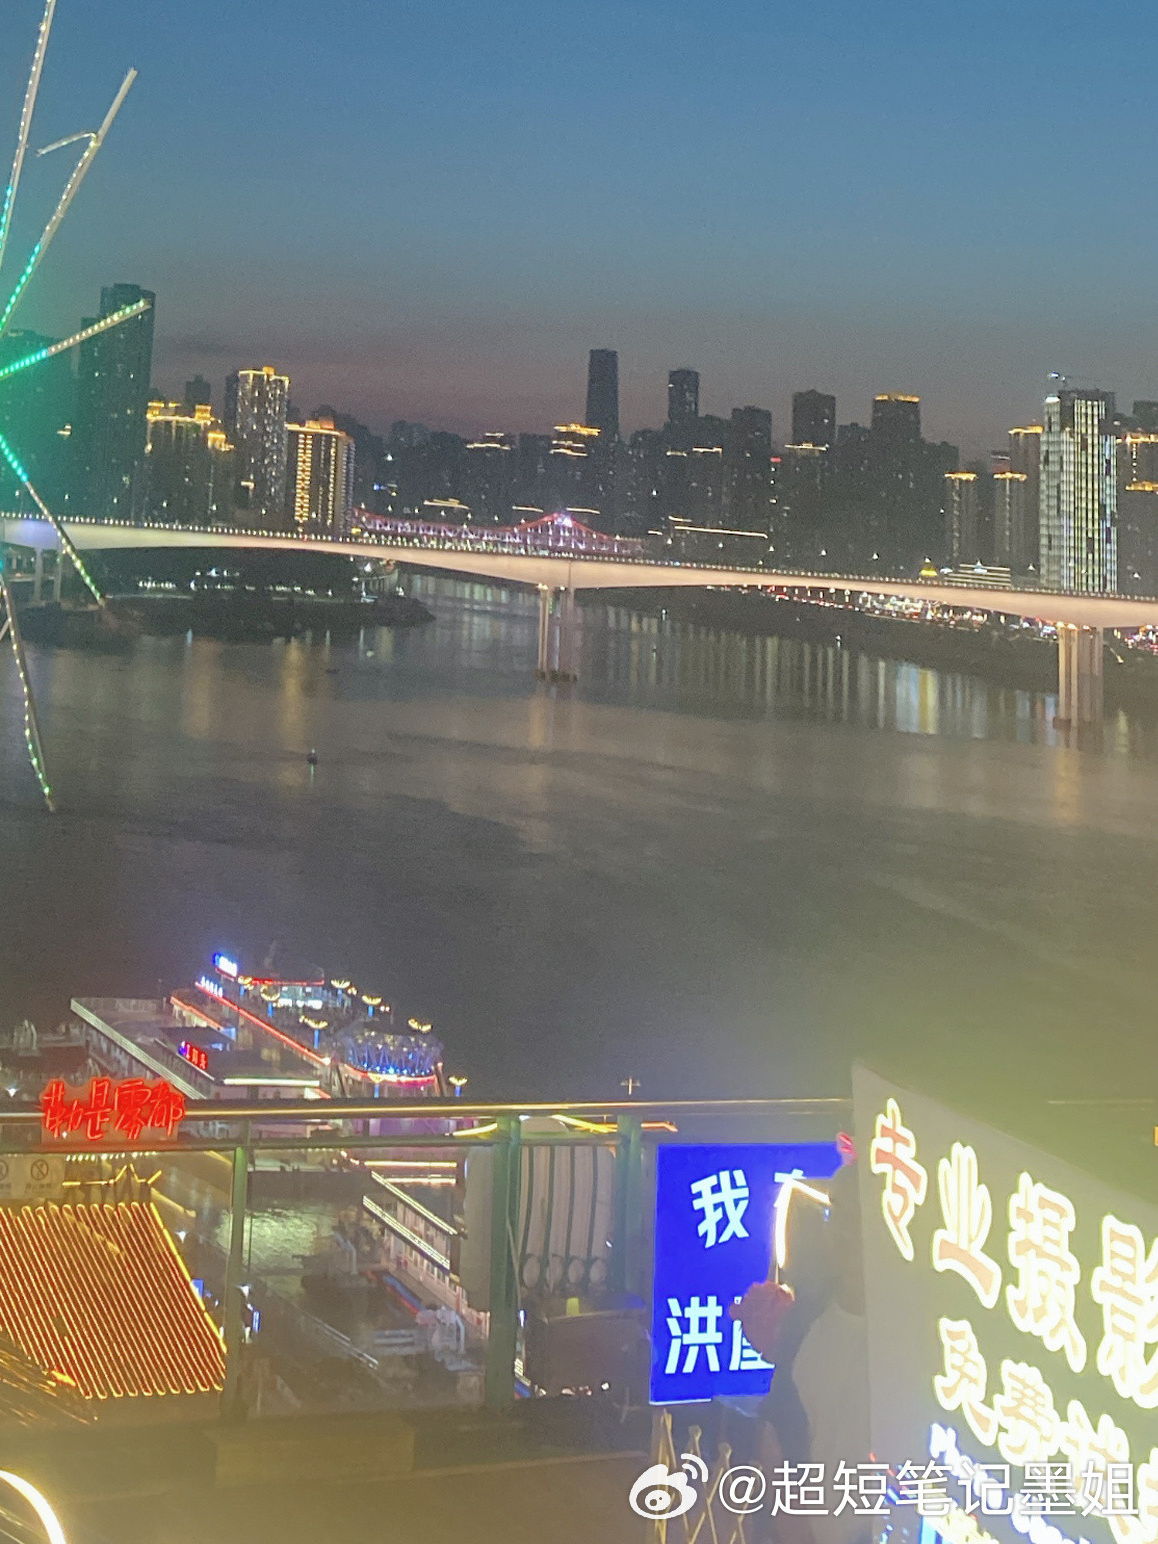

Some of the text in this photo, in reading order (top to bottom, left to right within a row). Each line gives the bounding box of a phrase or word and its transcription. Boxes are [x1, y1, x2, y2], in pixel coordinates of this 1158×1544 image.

[41, 1077, 186, 1140] 勒是雾都
[870, 1097, 1158, 1410] 专业摄影
